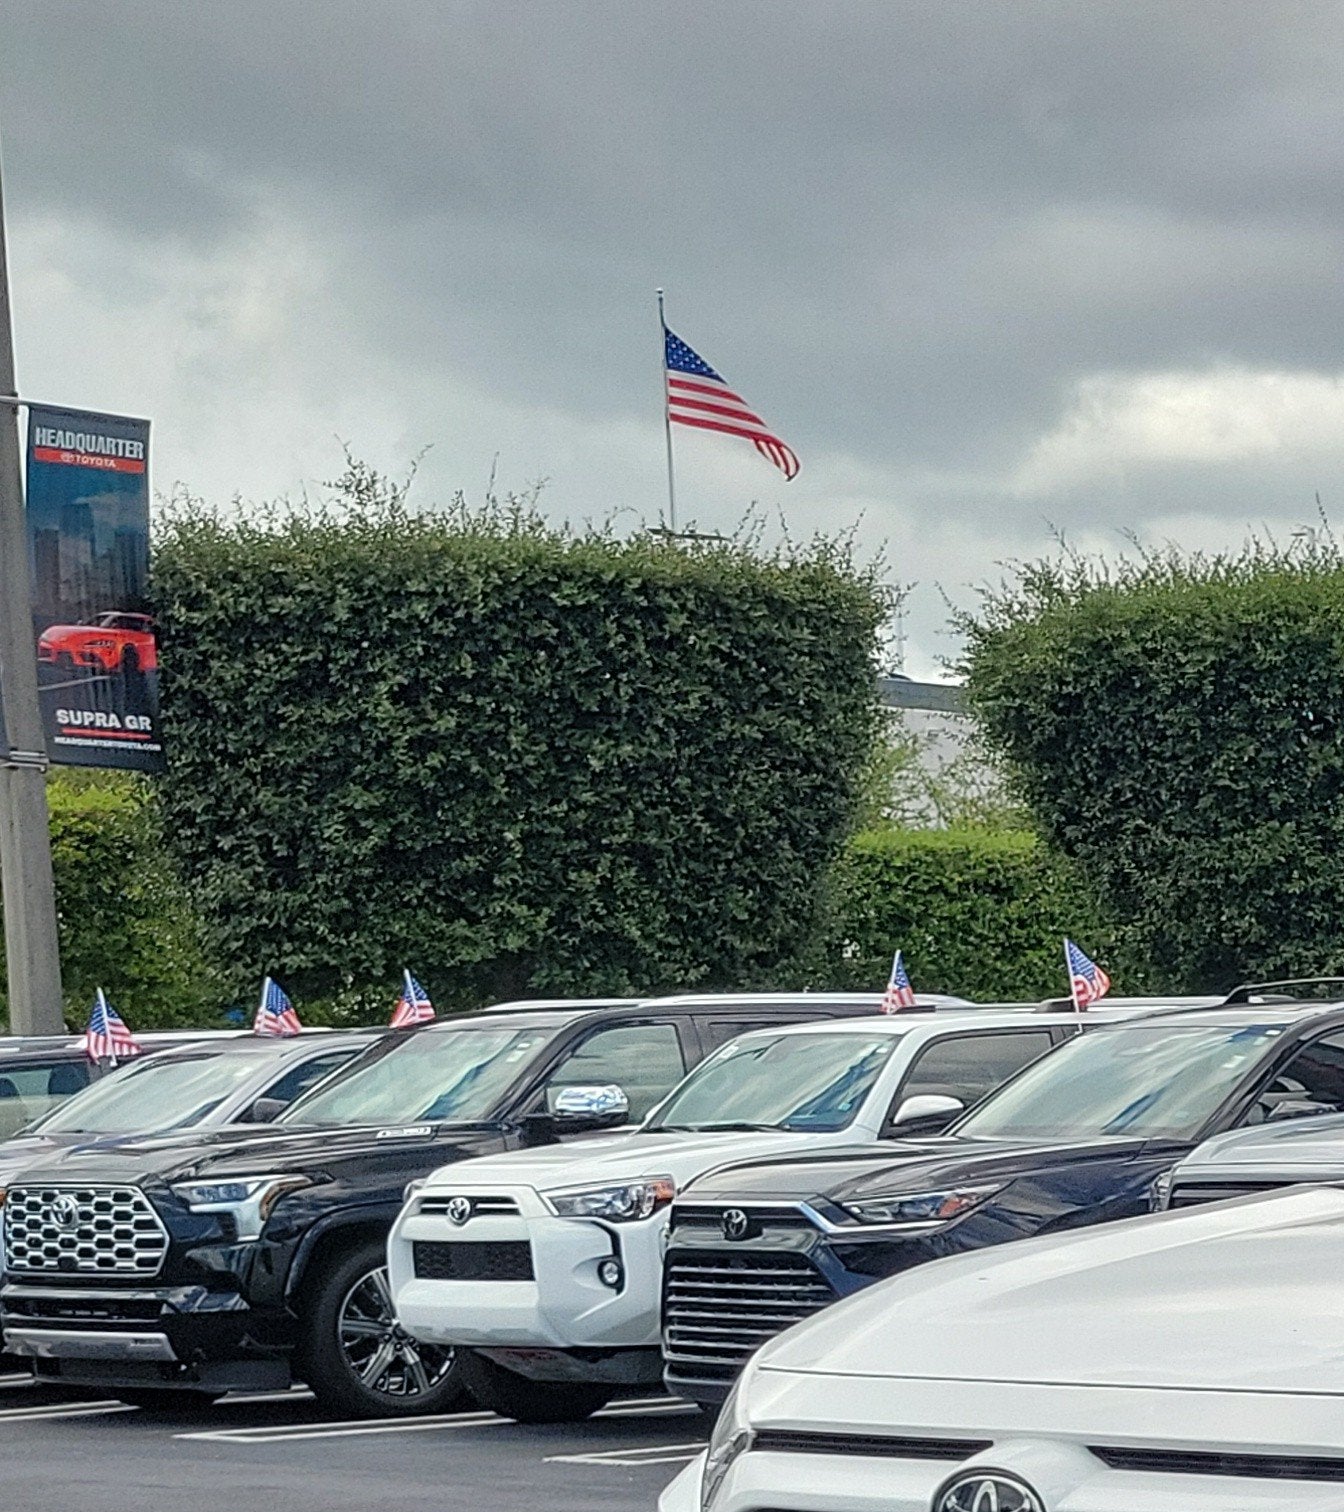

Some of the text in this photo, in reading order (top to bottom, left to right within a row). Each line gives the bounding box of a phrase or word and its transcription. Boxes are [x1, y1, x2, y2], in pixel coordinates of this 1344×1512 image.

[35, 426, 144, 459] HEADQUARTER
[75, 454, 117, 468] TOYOTA
[56, 709, 152, 731] SUPRA GR
